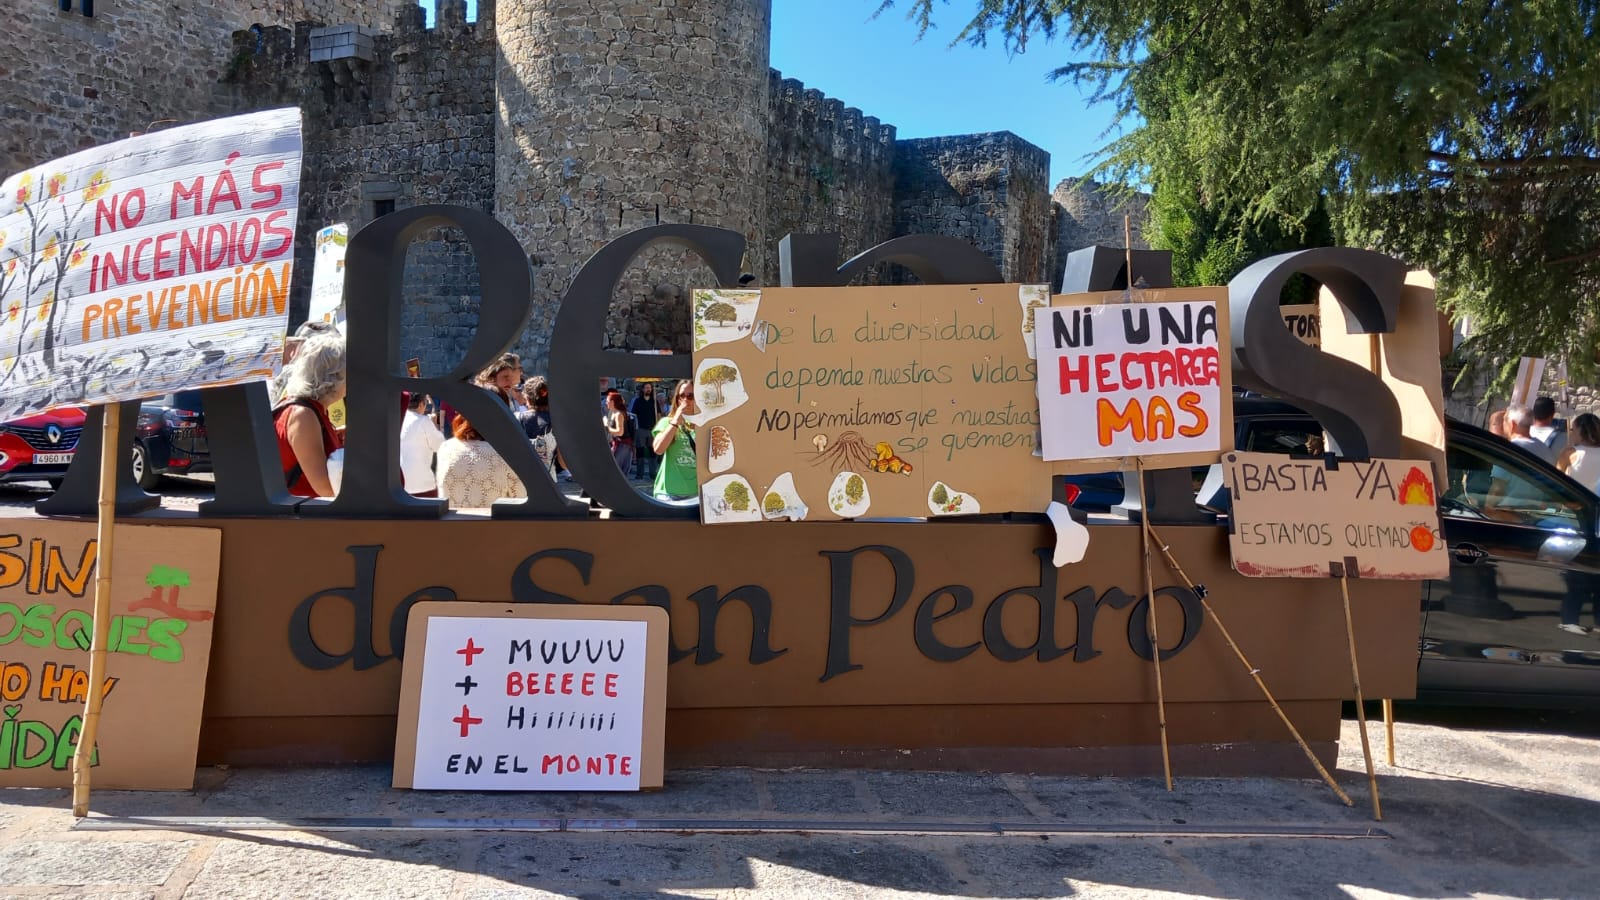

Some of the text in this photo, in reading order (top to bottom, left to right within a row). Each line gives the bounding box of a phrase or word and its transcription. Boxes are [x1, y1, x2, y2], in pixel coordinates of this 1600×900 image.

[95, 151, 285, 236] NO MÁS
[89, 210, 293, 293] INCENDIOS
[813, 313, 836, 344] la
[854, 307, 1003, 345] diversidad
[1122, 304, 1218, 345] UNA
[766, 355, 1038, 404] depende nuestras vidas
[1059, 347, 1219, 394] HECTAREA
[756, 409, 791, 433] NO
[793, 397, 903, 441] permitamos
[906, 408, 938, 433] que
[1097, 391, 1208, 447] MAS
[897, 431, 1034, 462] se quemen
[1351, 460, 1396, 502] YA
[1240, 522, 1332, 546] ESTAMOS
[818, 544, 1204, 682] Pedro
[0, 661, 32, 701] O
[507, 672, 619, 697] BEEEEE
[447, 754, 632, 776] EN EL MONTE
